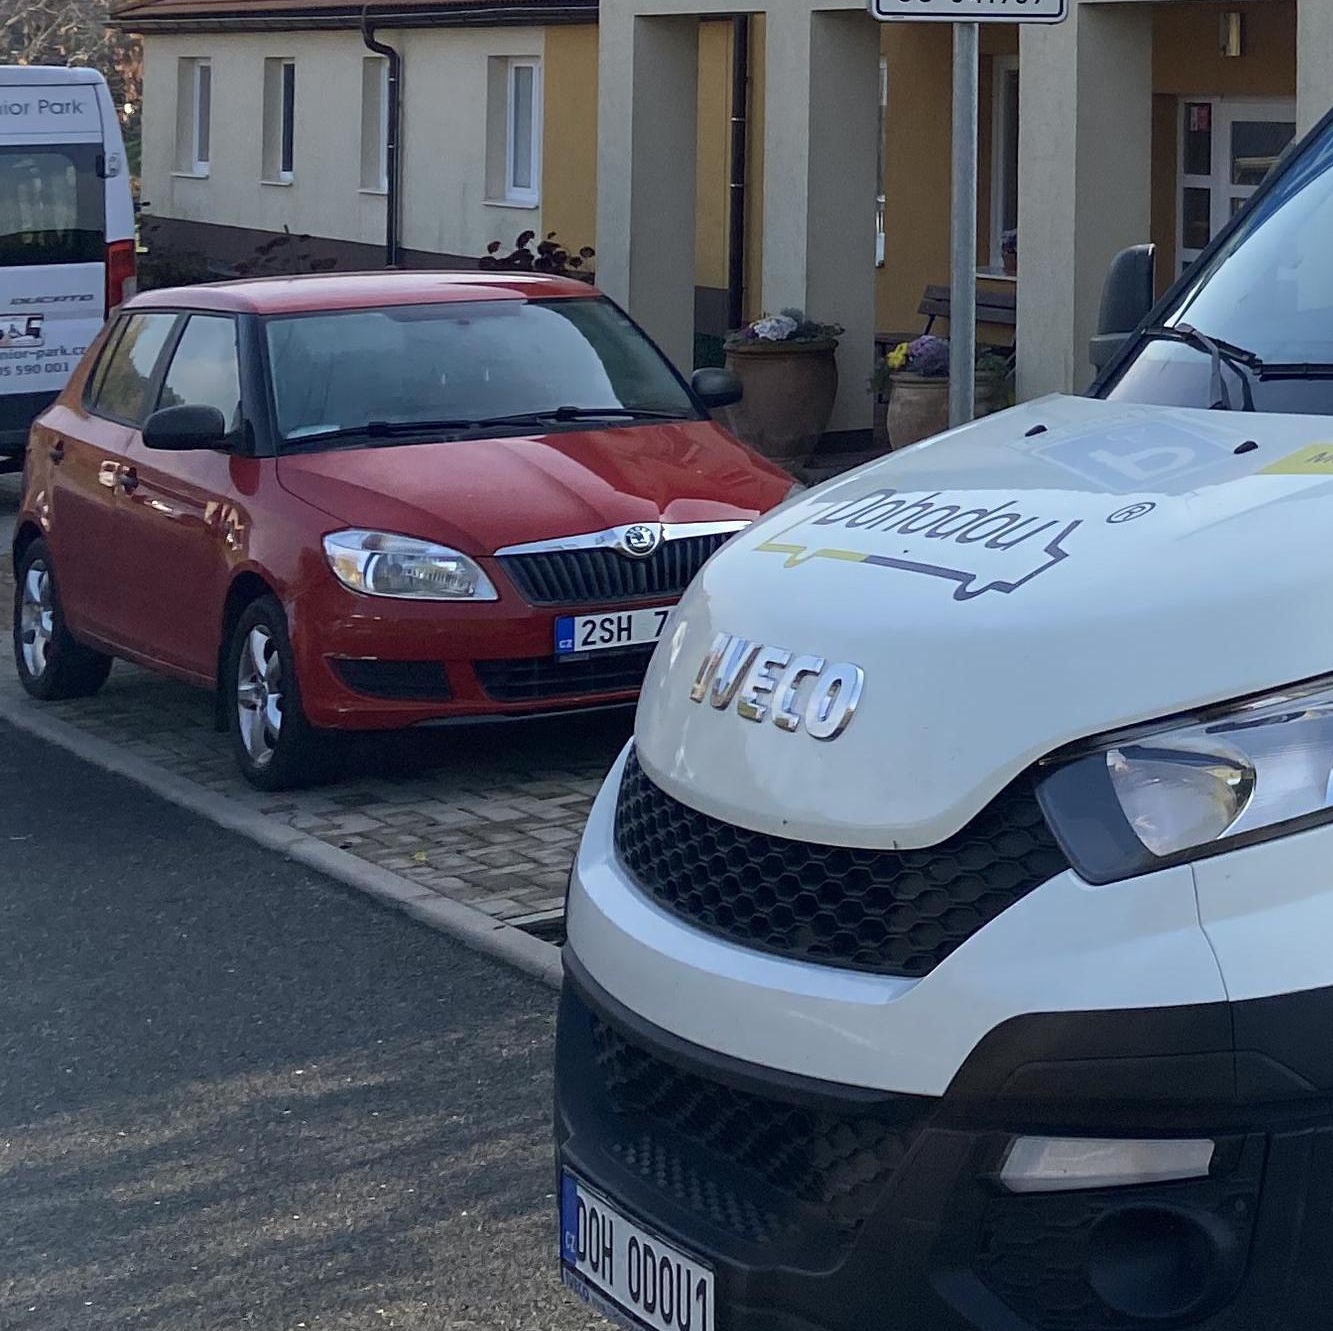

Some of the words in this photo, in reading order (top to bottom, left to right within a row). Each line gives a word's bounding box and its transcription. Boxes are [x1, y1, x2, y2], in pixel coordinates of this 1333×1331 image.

[38, 98, 84, 115] Park
[811, 488, 1060, 552] Dohodou
[581, 614, 633, 647] 2SH
[689, 631, 867, 743] IVECO
